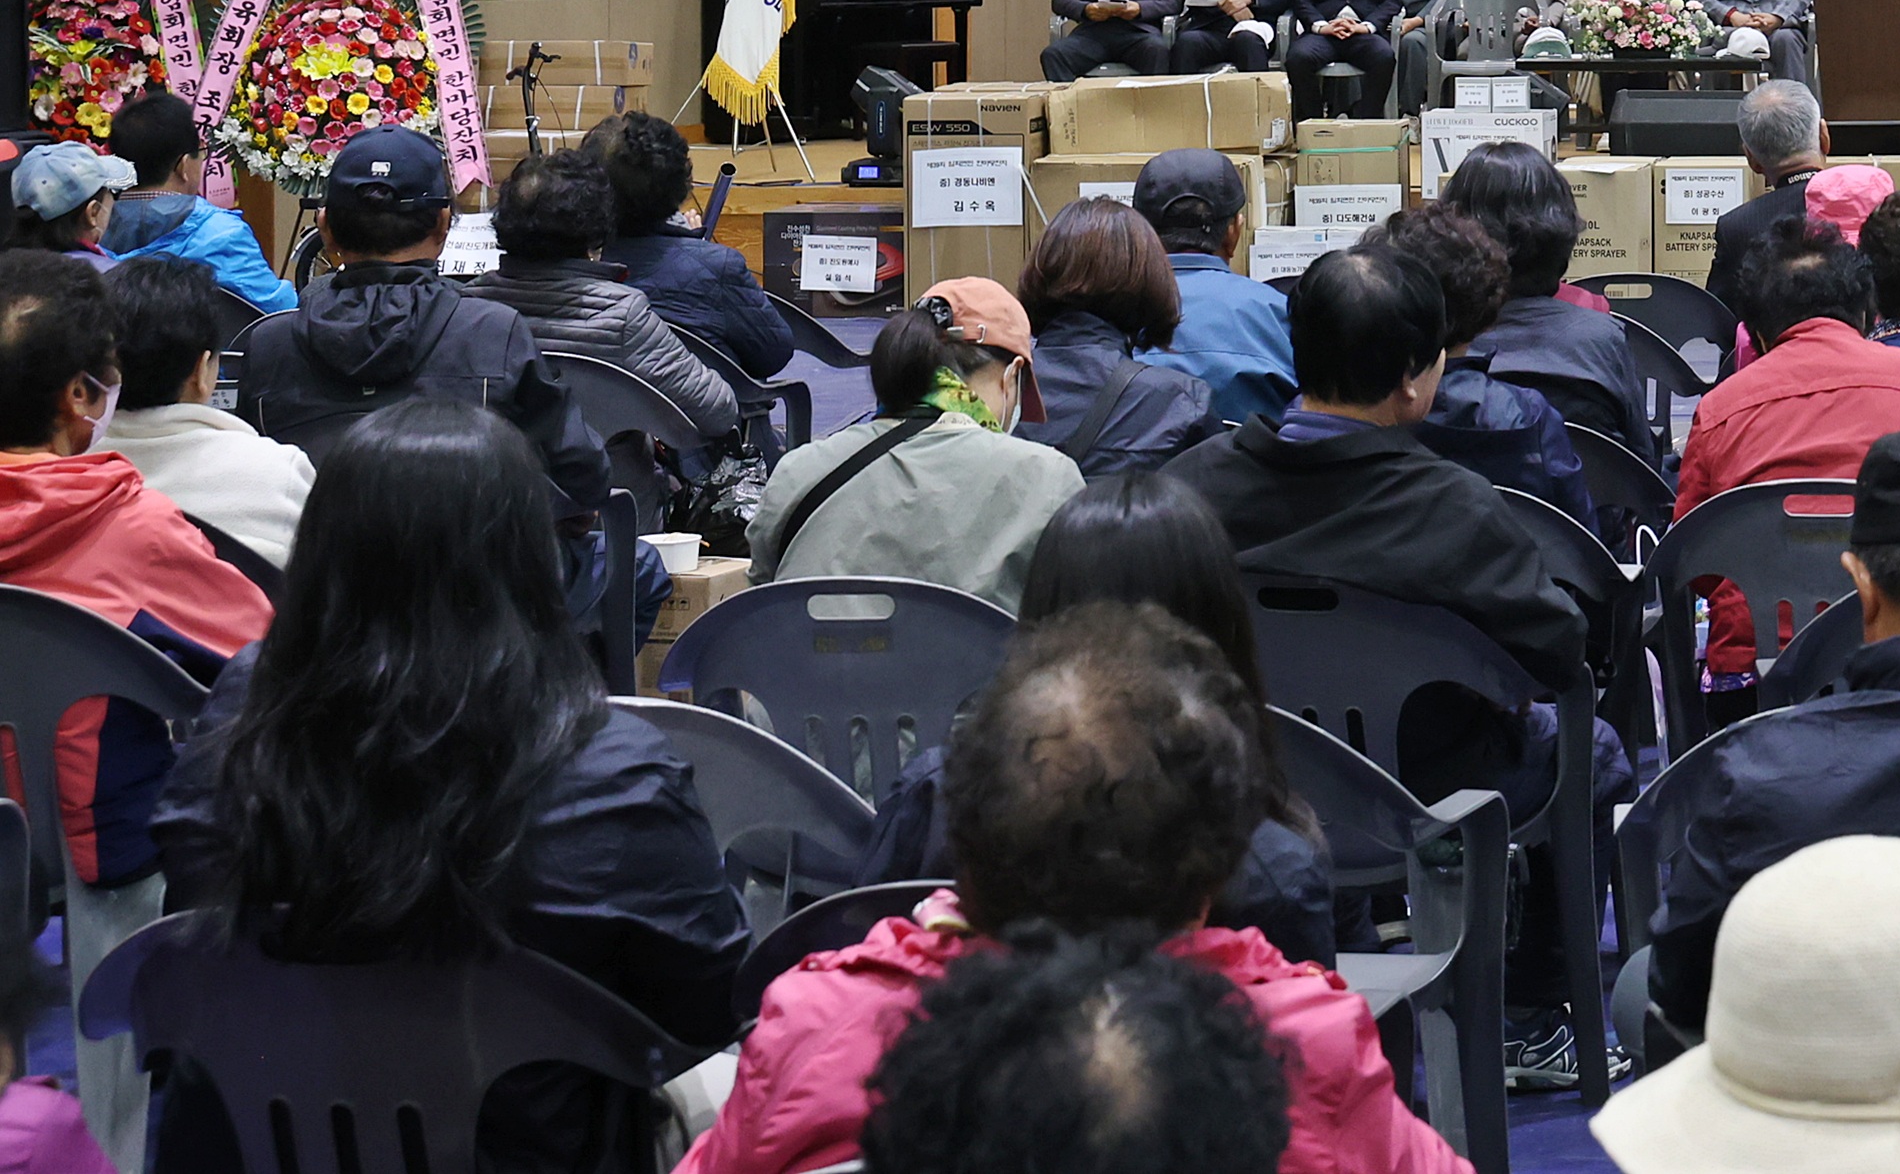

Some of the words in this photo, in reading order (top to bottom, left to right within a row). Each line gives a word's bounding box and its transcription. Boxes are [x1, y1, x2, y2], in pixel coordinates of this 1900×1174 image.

[443, 72, 479, 164] 한마당잔치
[1494, 118, 1538, 126] CUCKOO
[912, 124, 941, 132] ESW
[946, 124, 970, 132] 550
[1696, 190, 1724, 198] 성공수산
[1337, 214, 1376, 223] 다도해건설
[1666, 243, 1700, 252] BATTERY
[1590, 249, 1627, 258] SPRAYER
